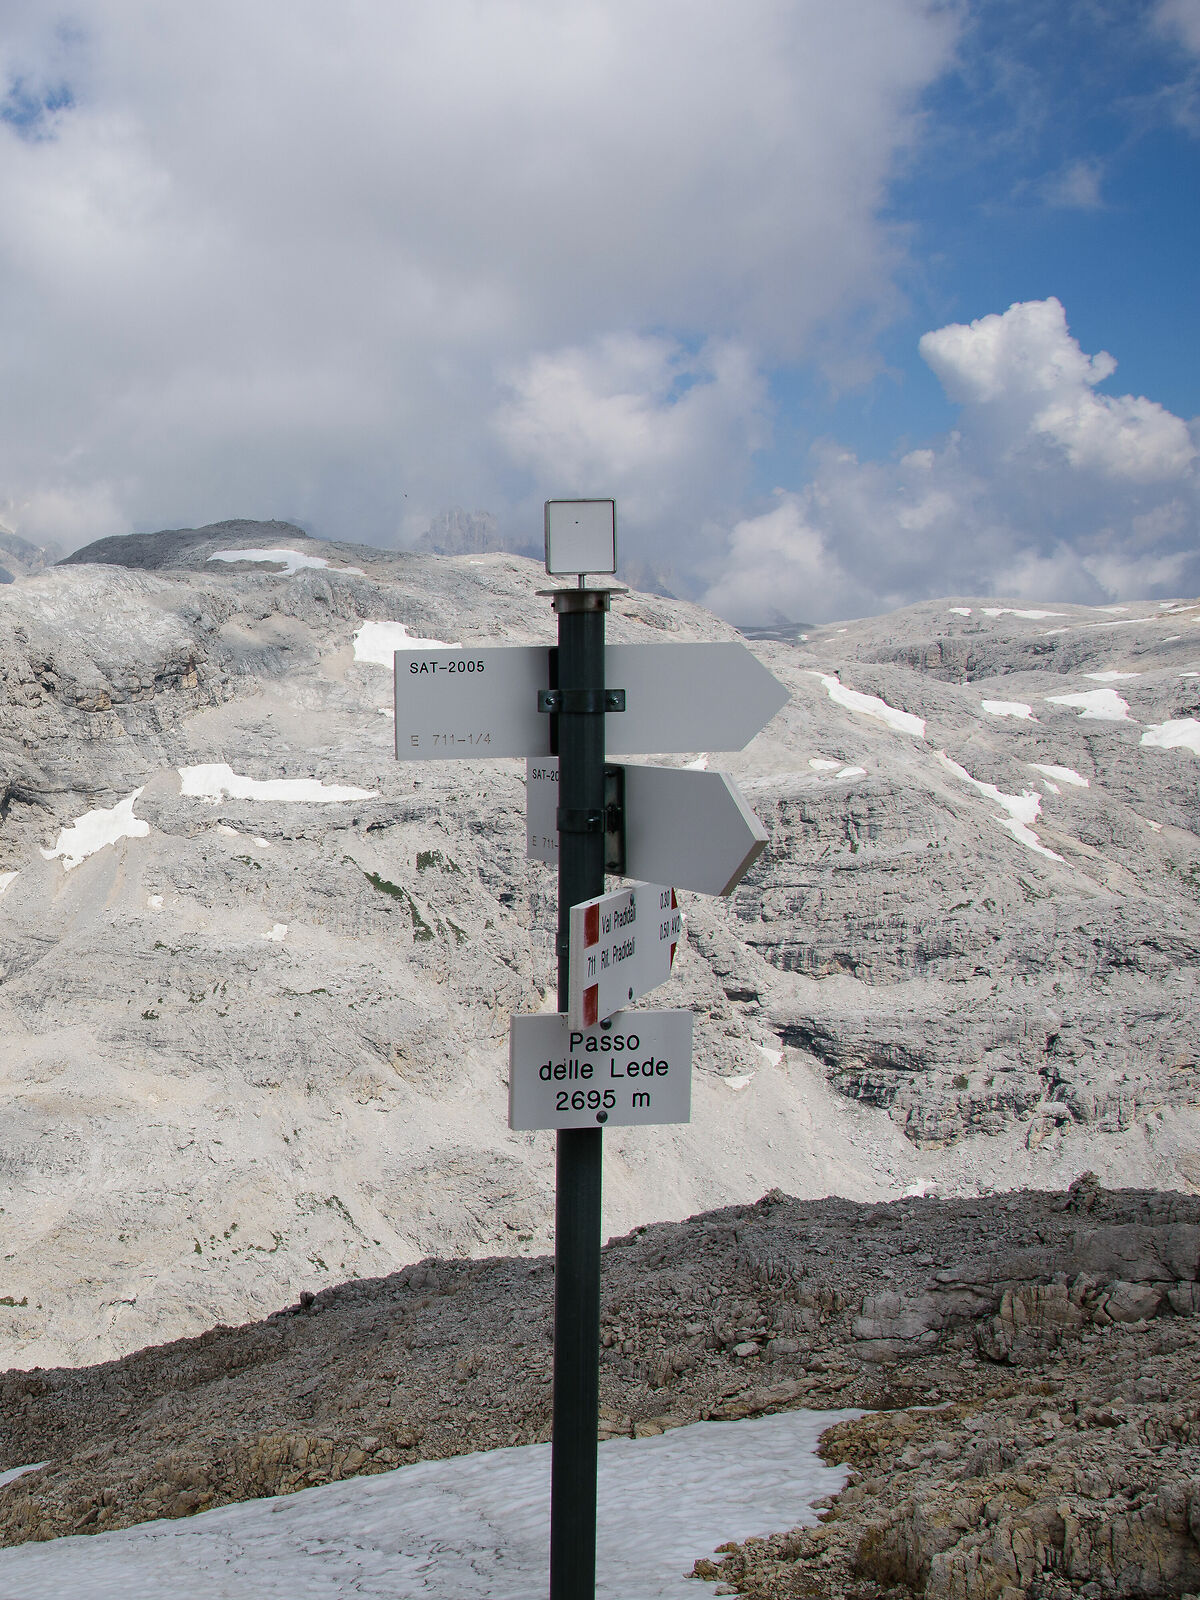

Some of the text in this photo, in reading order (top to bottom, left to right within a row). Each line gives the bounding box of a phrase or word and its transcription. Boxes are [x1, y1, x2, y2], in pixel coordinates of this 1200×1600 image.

[410, 660, 484, 674] SAT-2005
[410, 733, 491, 747] E 711-1/4
[532, 835, 537, 847] E
[602, 914, 612, 935] Val
[614, 904, 636, 927] Pradidali
[587, 955, 596, 977] 711
[601, 949, 610, 970] Rif.
[612, 936, 636, 964] Pradidali
[569, 1032, 640, 1053] Passo
[539, 1057, 669, 1081] delle Lede
[556, 1089, 650, 1111] 2695 m
